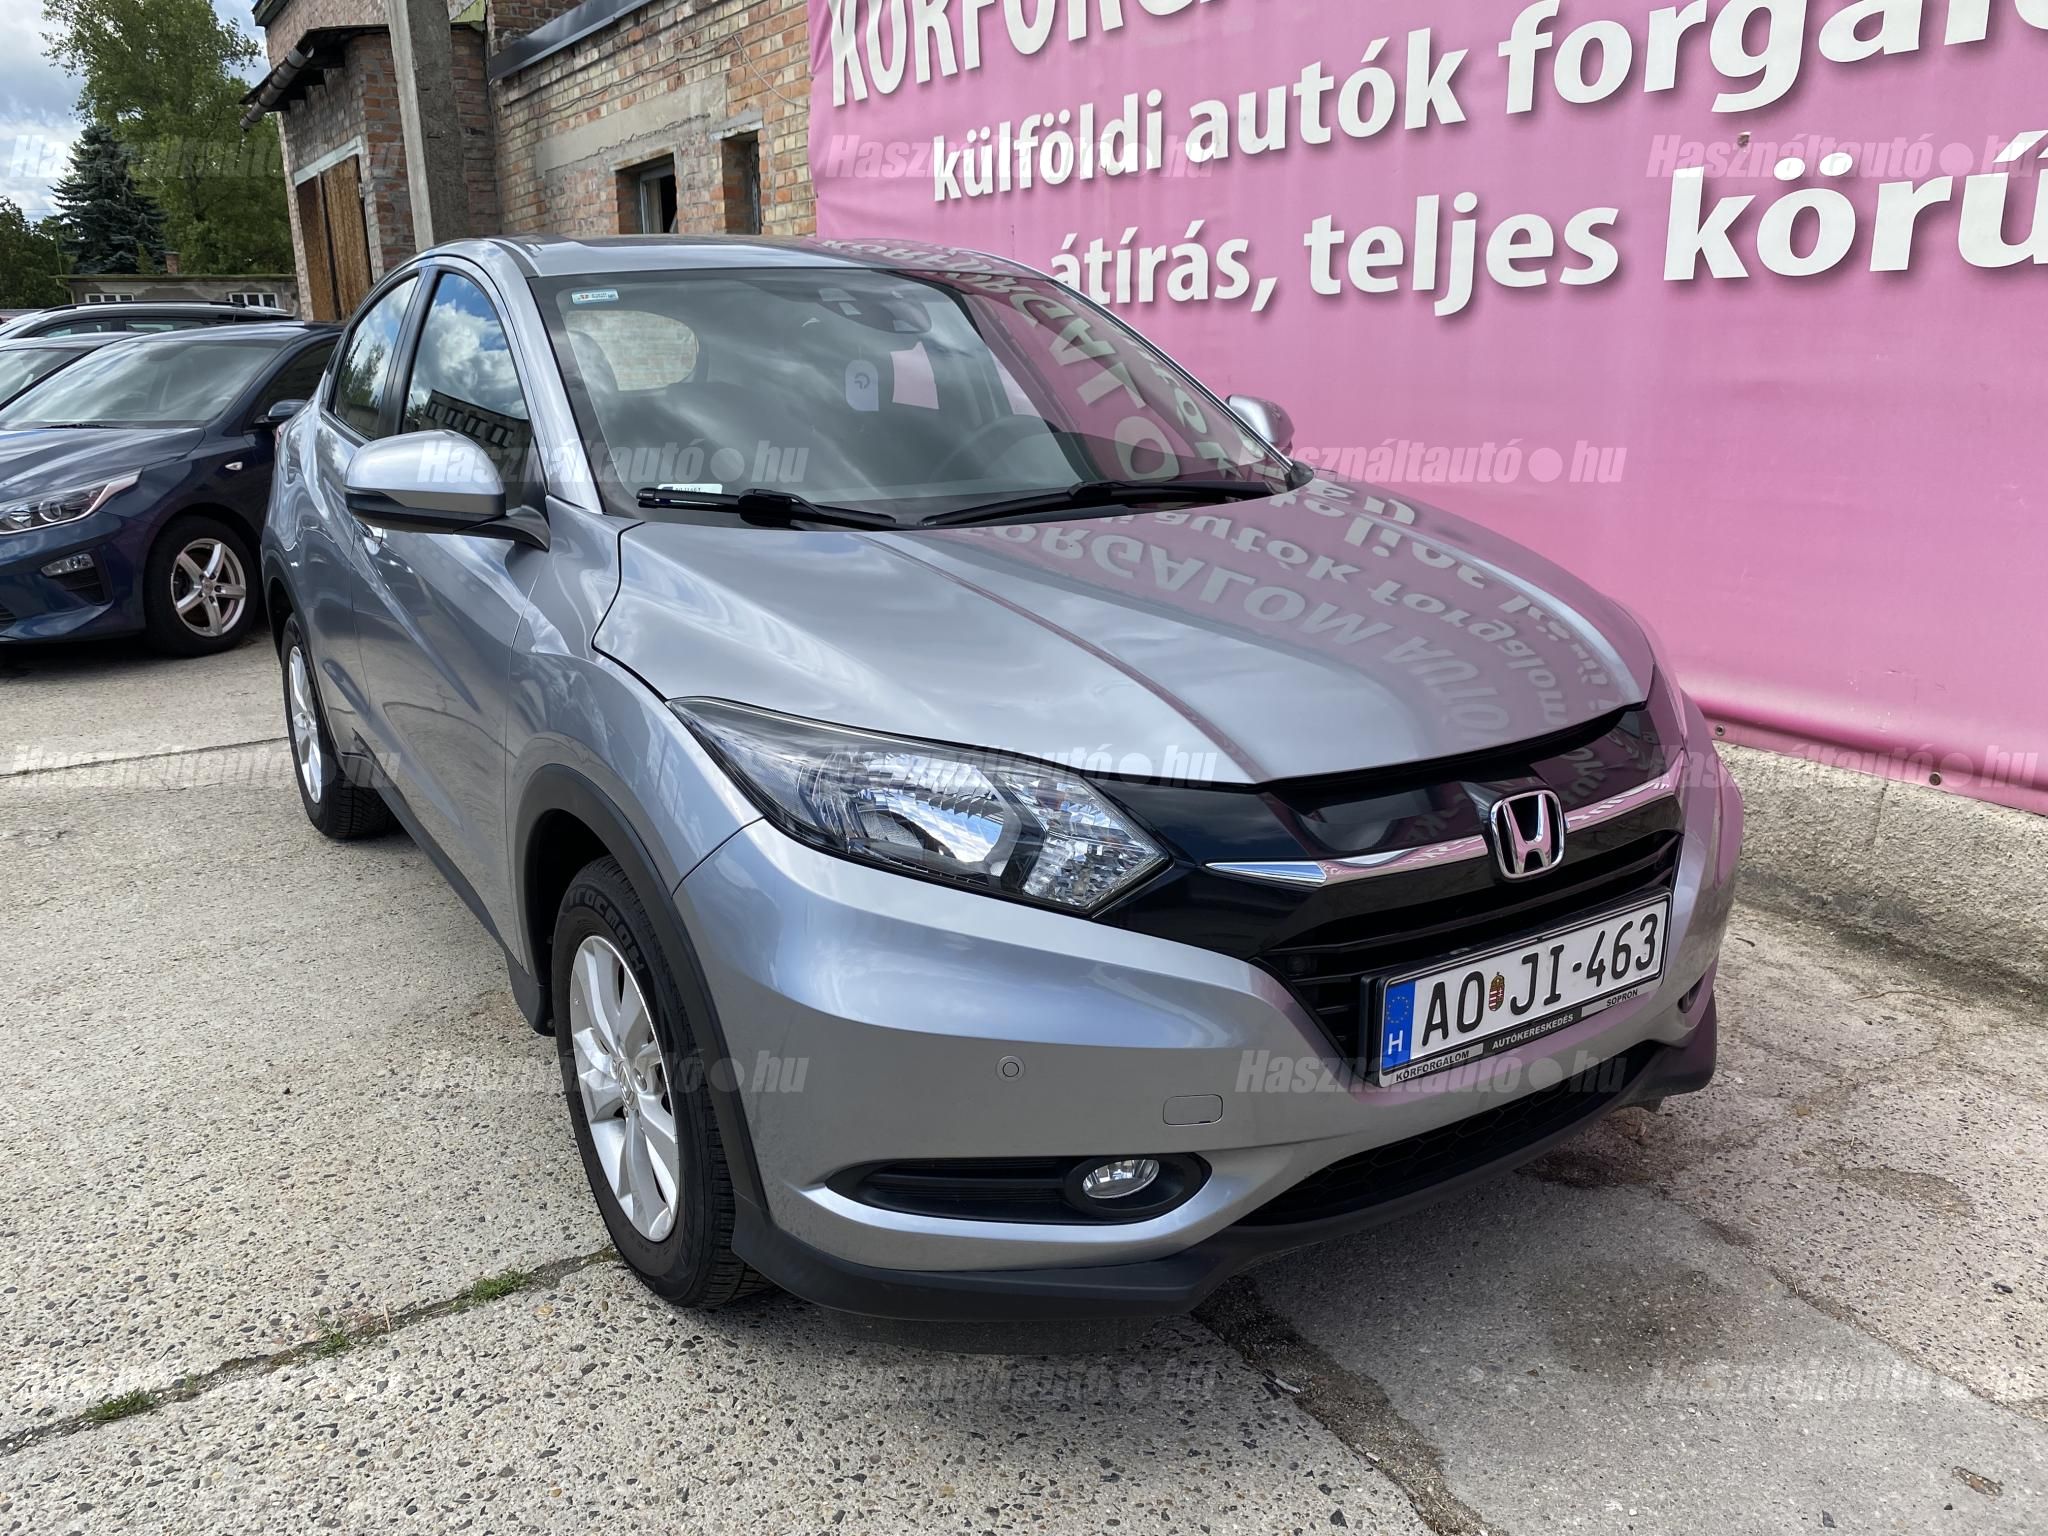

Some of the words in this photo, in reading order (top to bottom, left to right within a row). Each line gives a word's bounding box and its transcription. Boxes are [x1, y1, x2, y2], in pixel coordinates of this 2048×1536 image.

[932, 88, 1163, 203] külföldi
[1184, 27, 1468, 164] autók
[1050, 218, 1278, 314] átírás,
[1303, 191, 1619, 318] teljes
[1387, 1029, 1404, 1056] H
[1421, 970, 1485, 1047] AO
[1491, 1013, 1574, 1050] AUTÓKERESKEDÉS
[1606, 988, 1639, 1007] SOPRON
